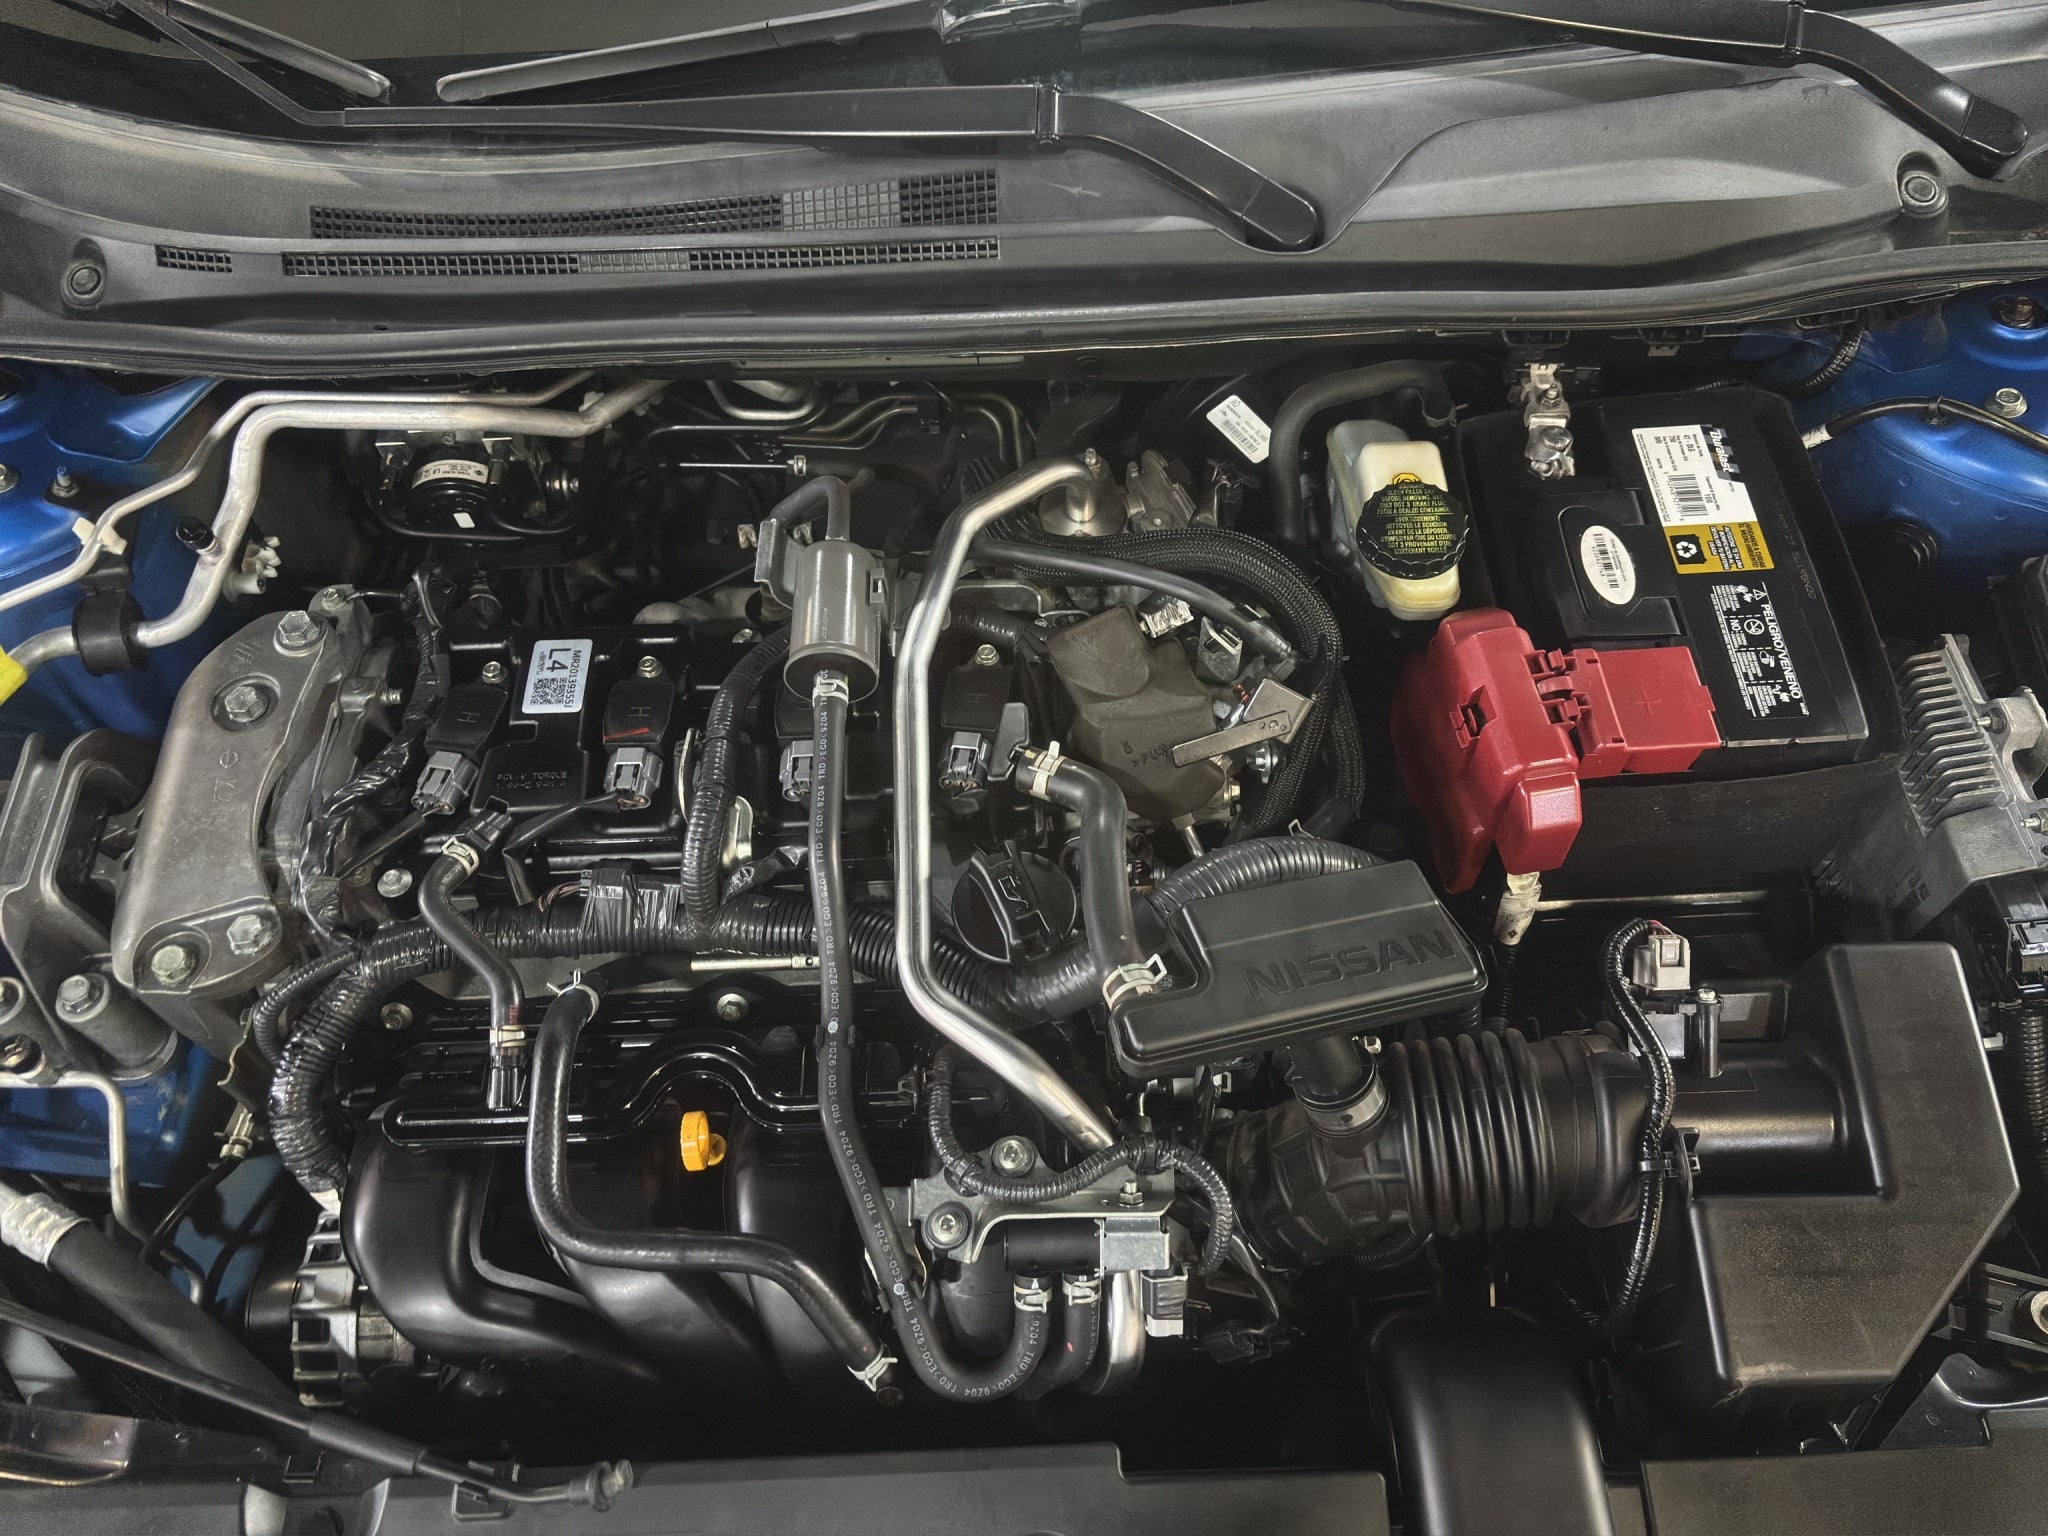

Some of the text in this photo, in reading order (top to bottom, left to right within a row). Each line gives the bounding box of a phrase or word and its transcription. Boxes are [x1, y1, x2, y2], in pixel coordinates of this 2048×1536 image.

[1708, 429, 1735, 472] Duralast
[545, 647, 572, 672] L4
[563, 649, 581, 707] MR20139355J
[1759, 603, 1802, 699] PELIGRO/VENENO
[1242, 929, 1457, 998] NISSAN
